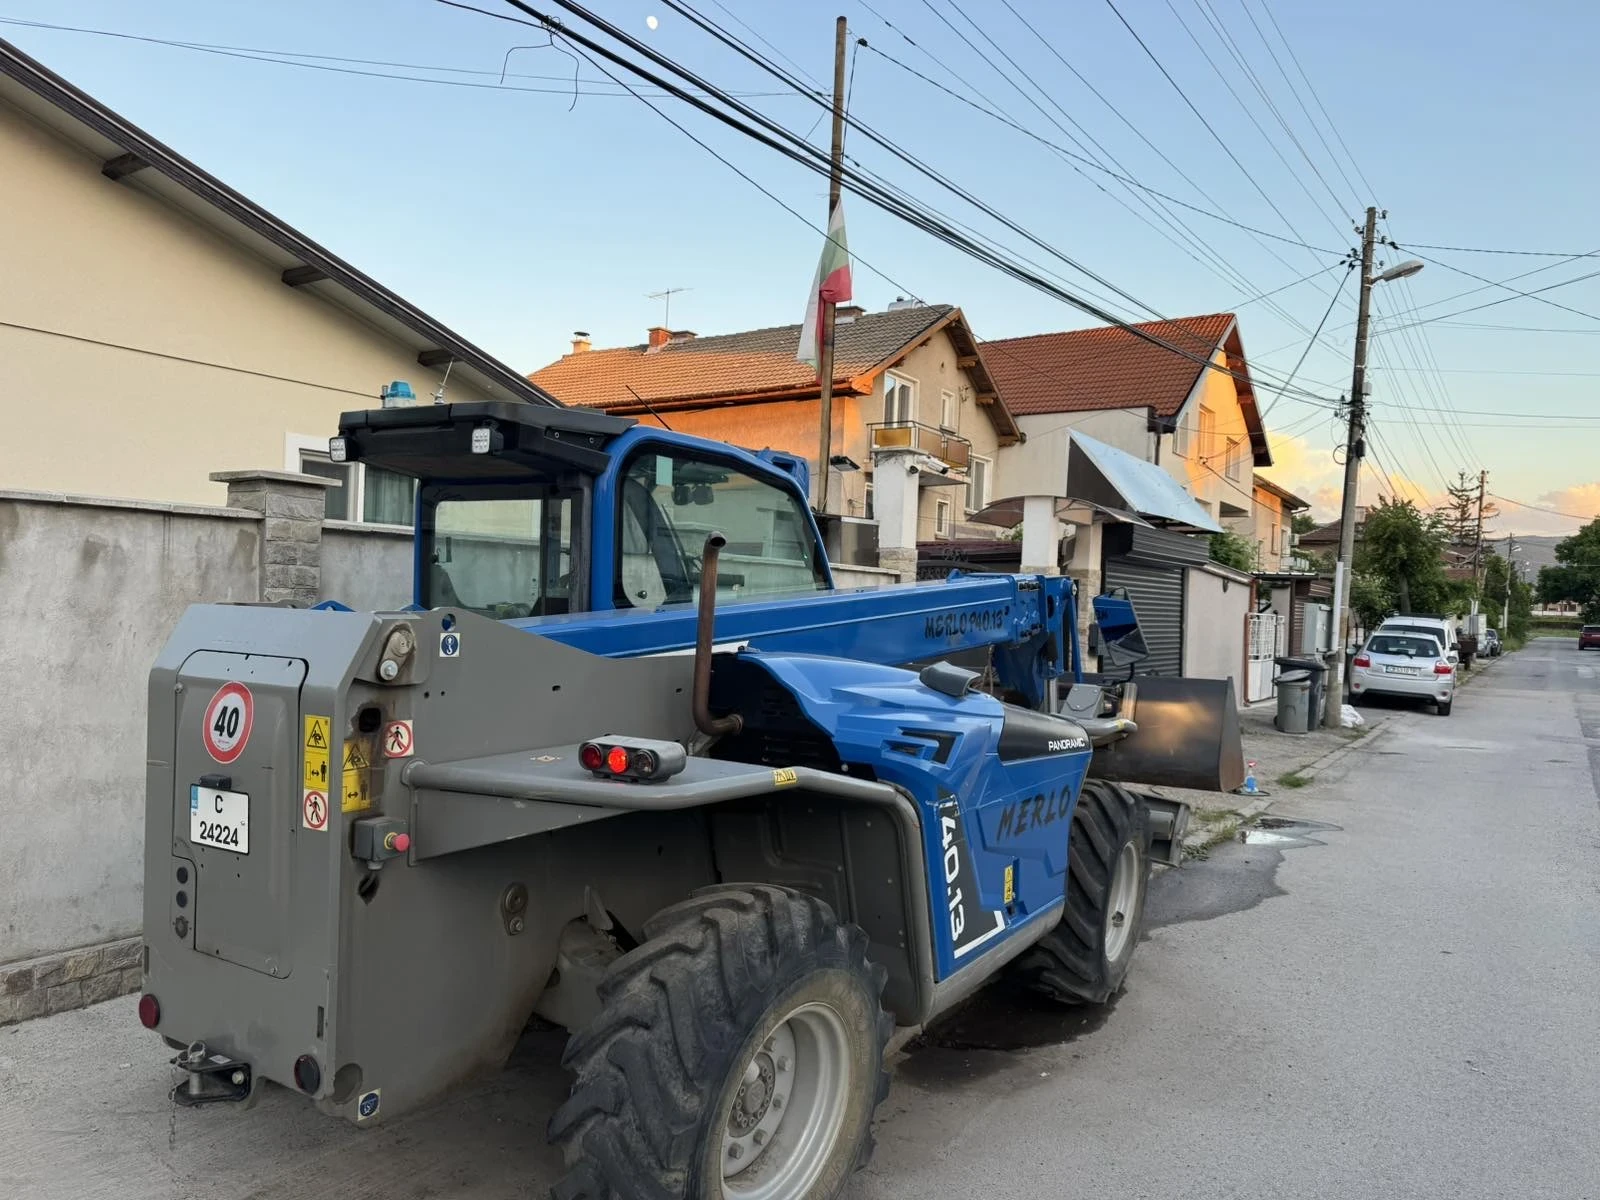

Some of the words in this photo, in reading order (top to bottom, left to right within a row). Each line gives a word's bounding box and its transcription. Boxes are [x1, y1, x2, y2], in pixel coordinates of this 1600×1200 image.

[925, 611, 967, 639] MERLO
[214, 706, 239, 738] 40
[1047, 737, 1086, 752] PANORAMIC
[215, 795, 223, 813] C
[996, 784, 1071, 841] MERLO
[199, 820, 239, 847] 24224
